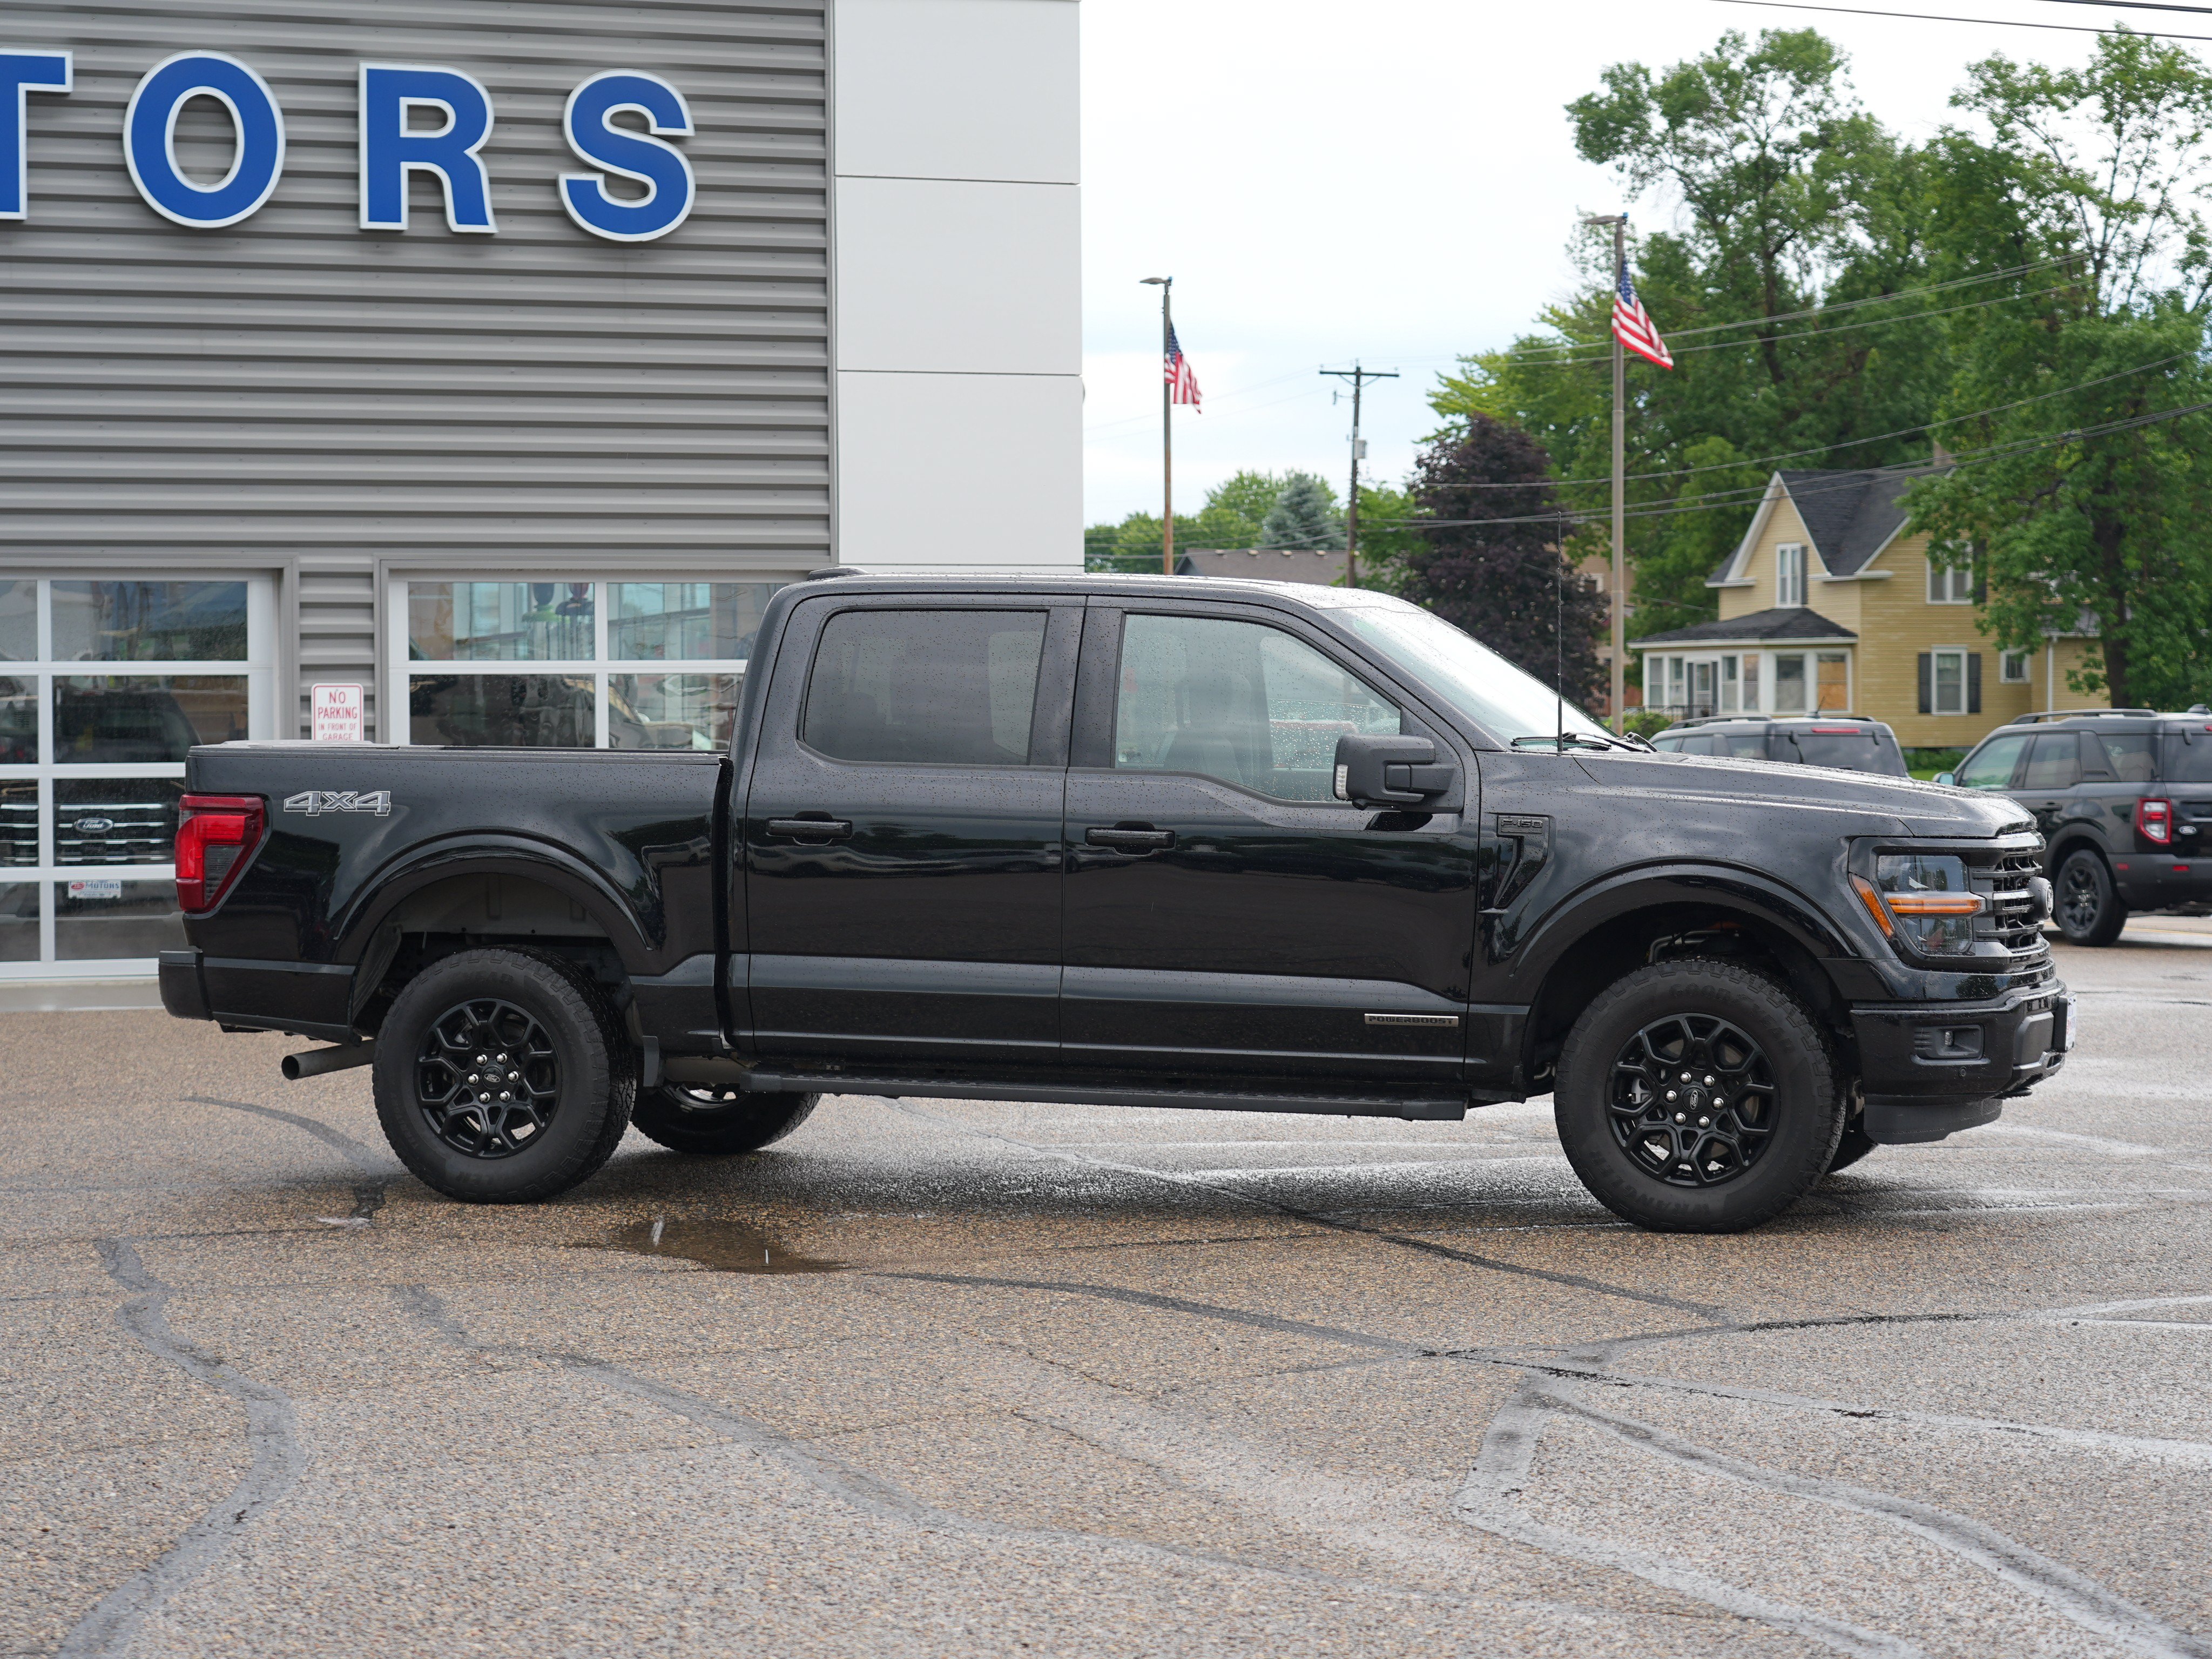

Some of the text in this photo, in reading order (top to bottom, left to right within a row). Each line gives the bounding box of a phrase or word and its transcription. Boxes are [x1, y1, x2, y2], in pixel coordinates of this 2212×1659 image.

[329, 691, 346, 704] NO
[318, 706, 358, 719] PARKING
[322, 732, 354, 740] GARAGE
[1501, 819, 1543, 828] F-150
[1369, 1016, 1454, 1024] POWERBOOST
